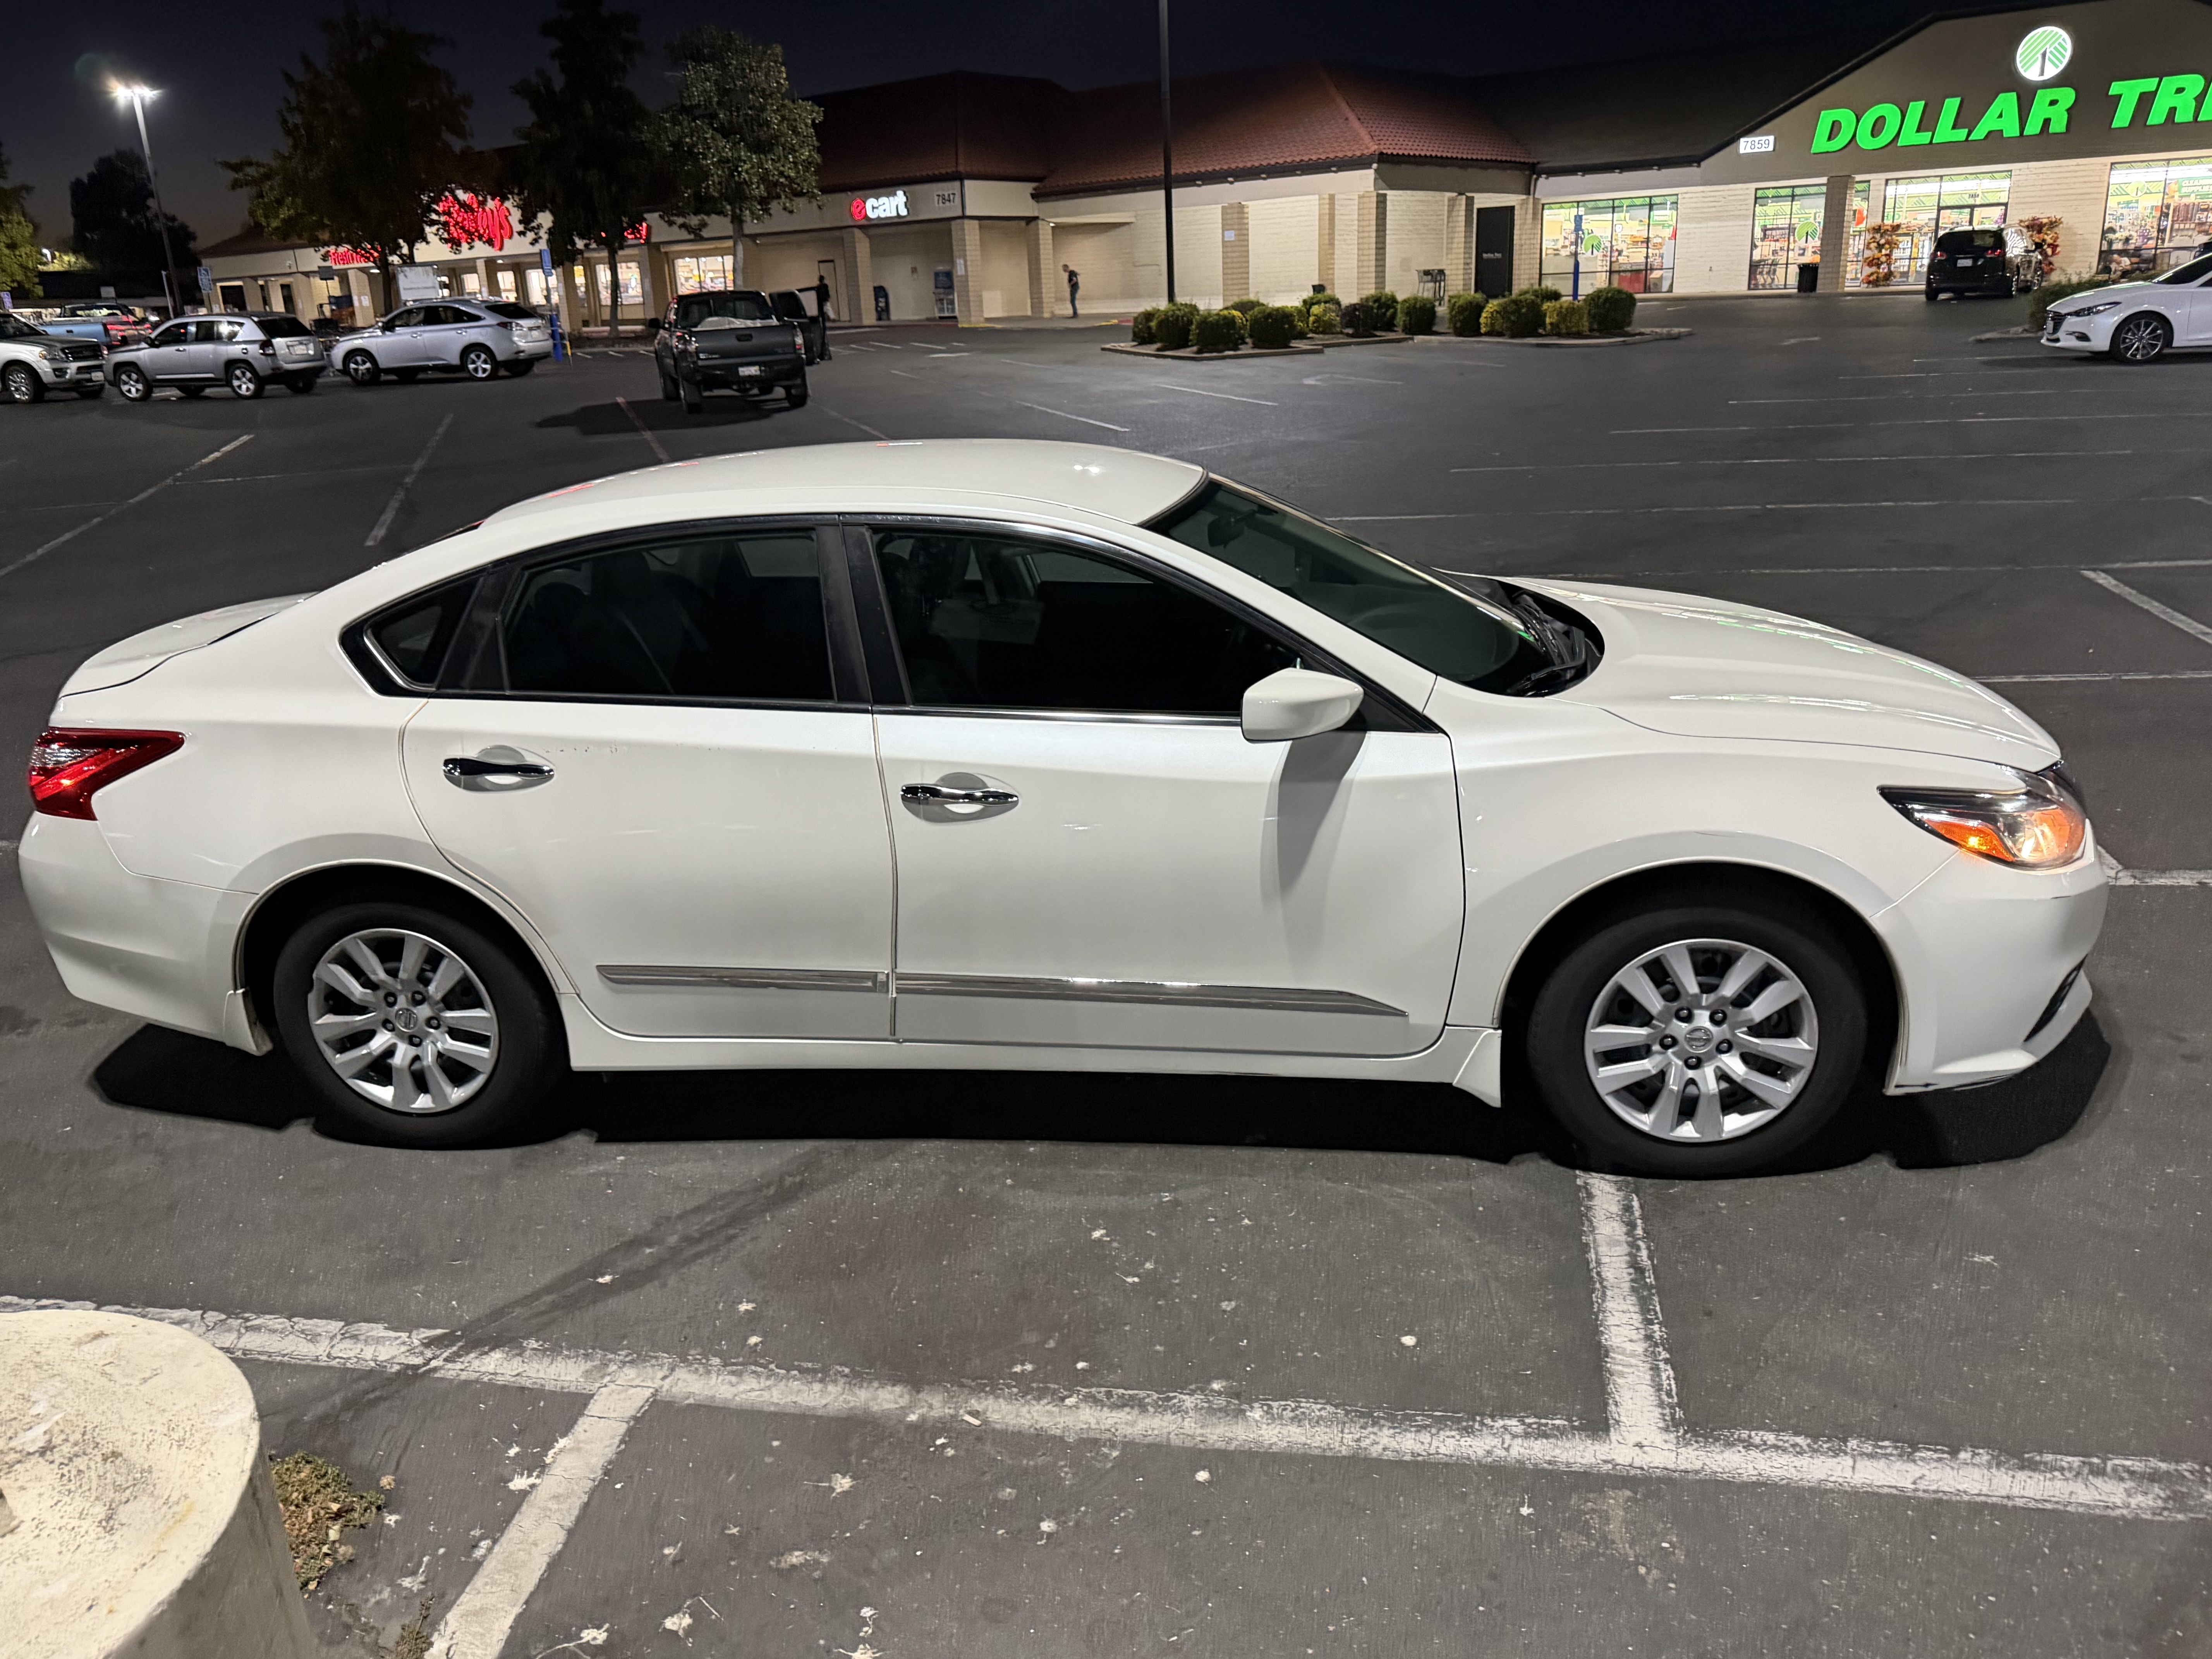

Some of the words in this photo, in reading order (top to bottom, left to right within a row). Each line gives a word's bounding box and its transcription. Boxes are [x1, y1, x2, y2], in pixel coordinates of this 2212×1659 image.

[1811, 87, 2076, 153] DOLLAR
[2108, 74, 2212, 129] TR
[1743, 139, 1770, 151] 7859
[936, 193, 956, 205] 7847
